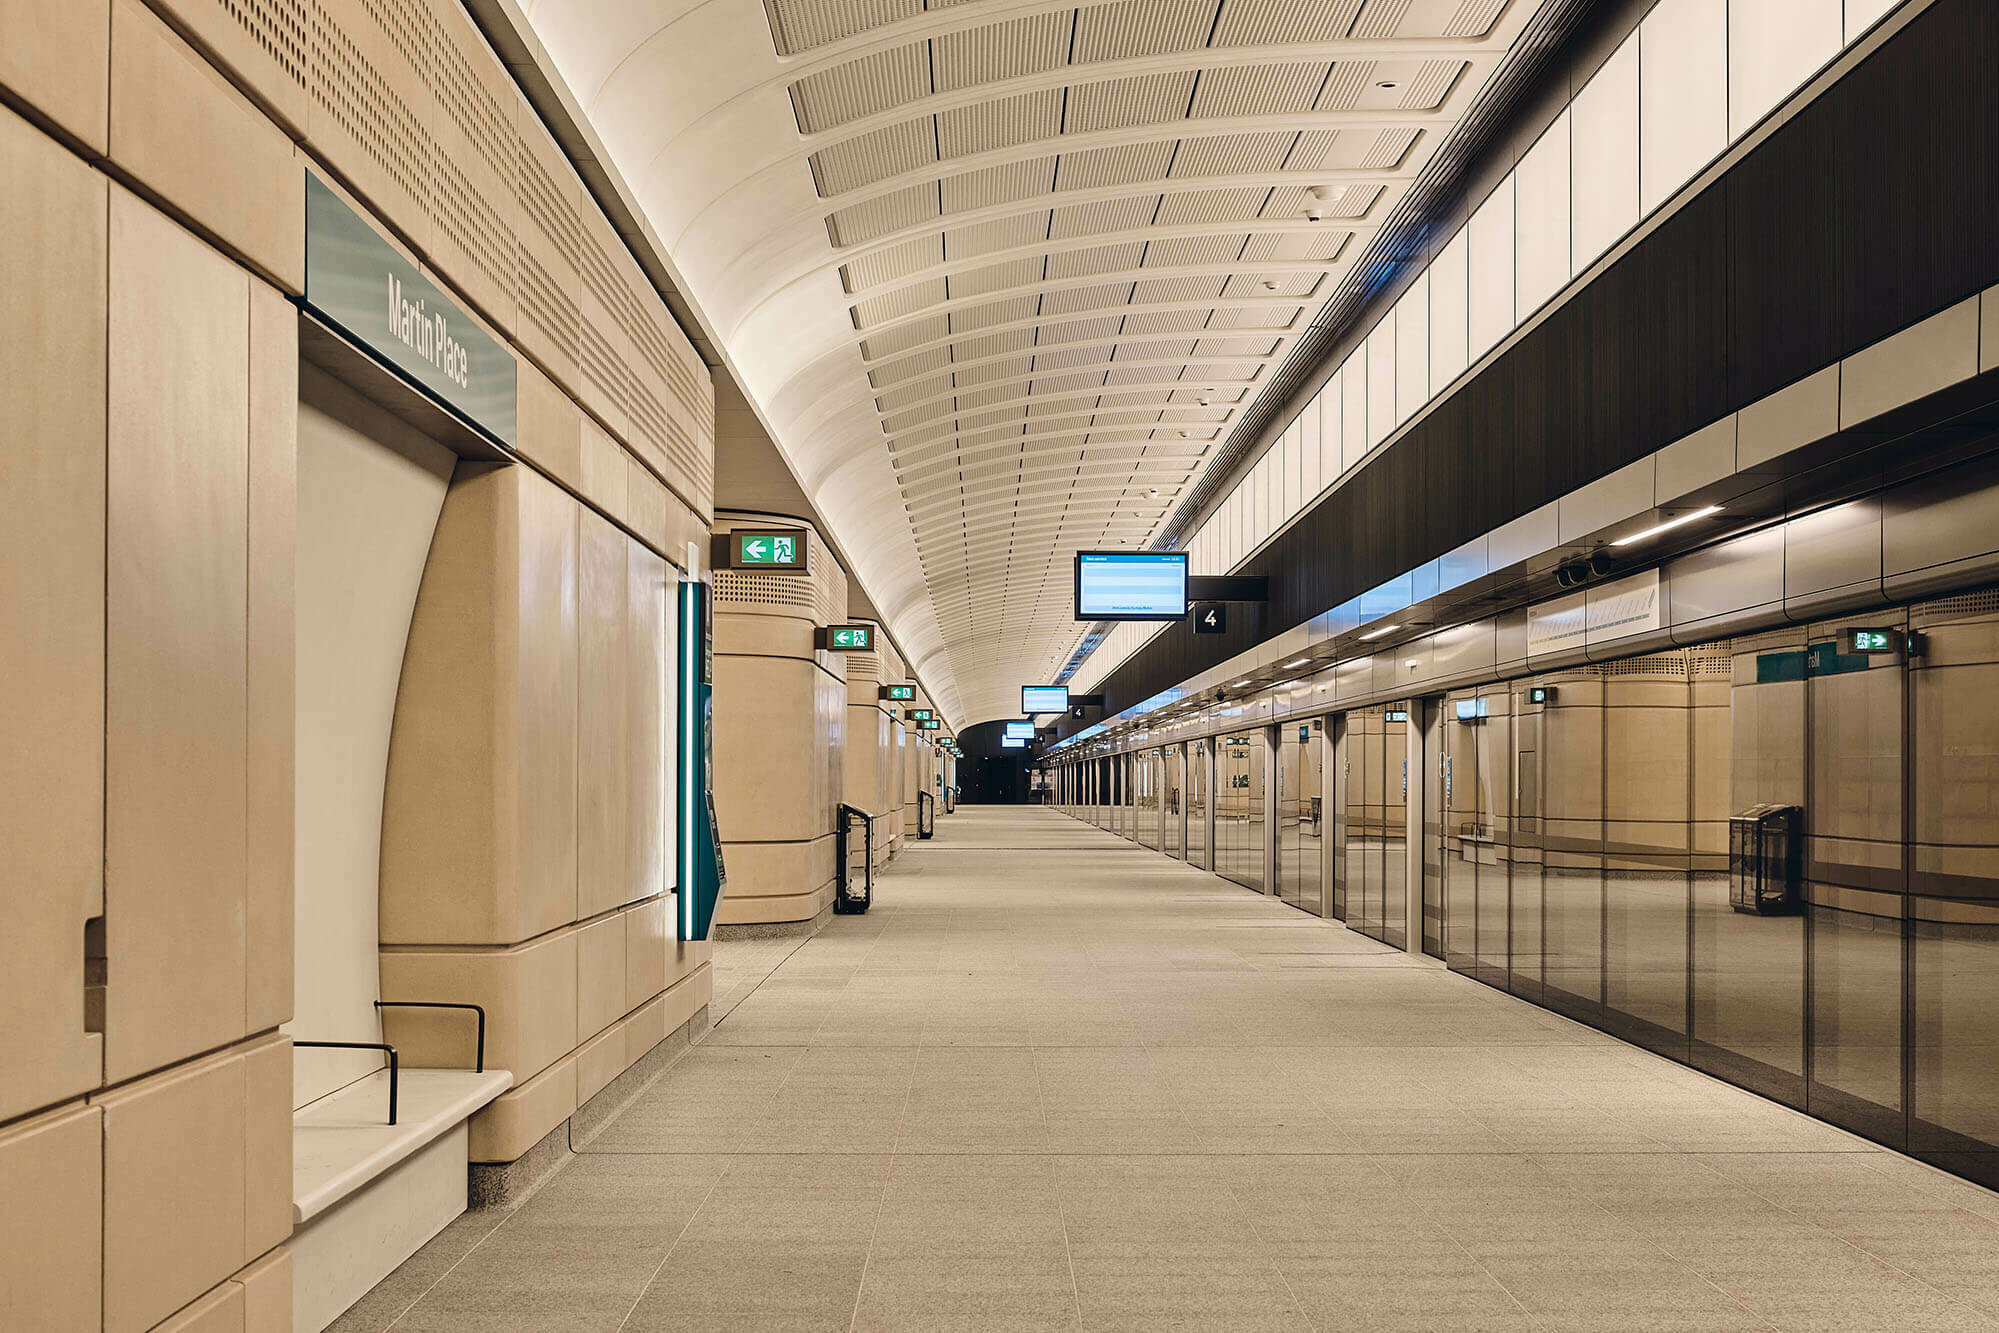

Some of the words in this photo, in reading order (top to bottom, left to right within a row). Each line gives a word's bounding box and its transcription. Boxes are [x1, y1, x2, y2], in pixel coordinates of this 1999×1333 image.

[388, 271, 433, 363] Martin
[435, 312, 468, 389] Place
[1204, 609, 1217, 627] 4
[1075, 708, 1081, 717] 4
